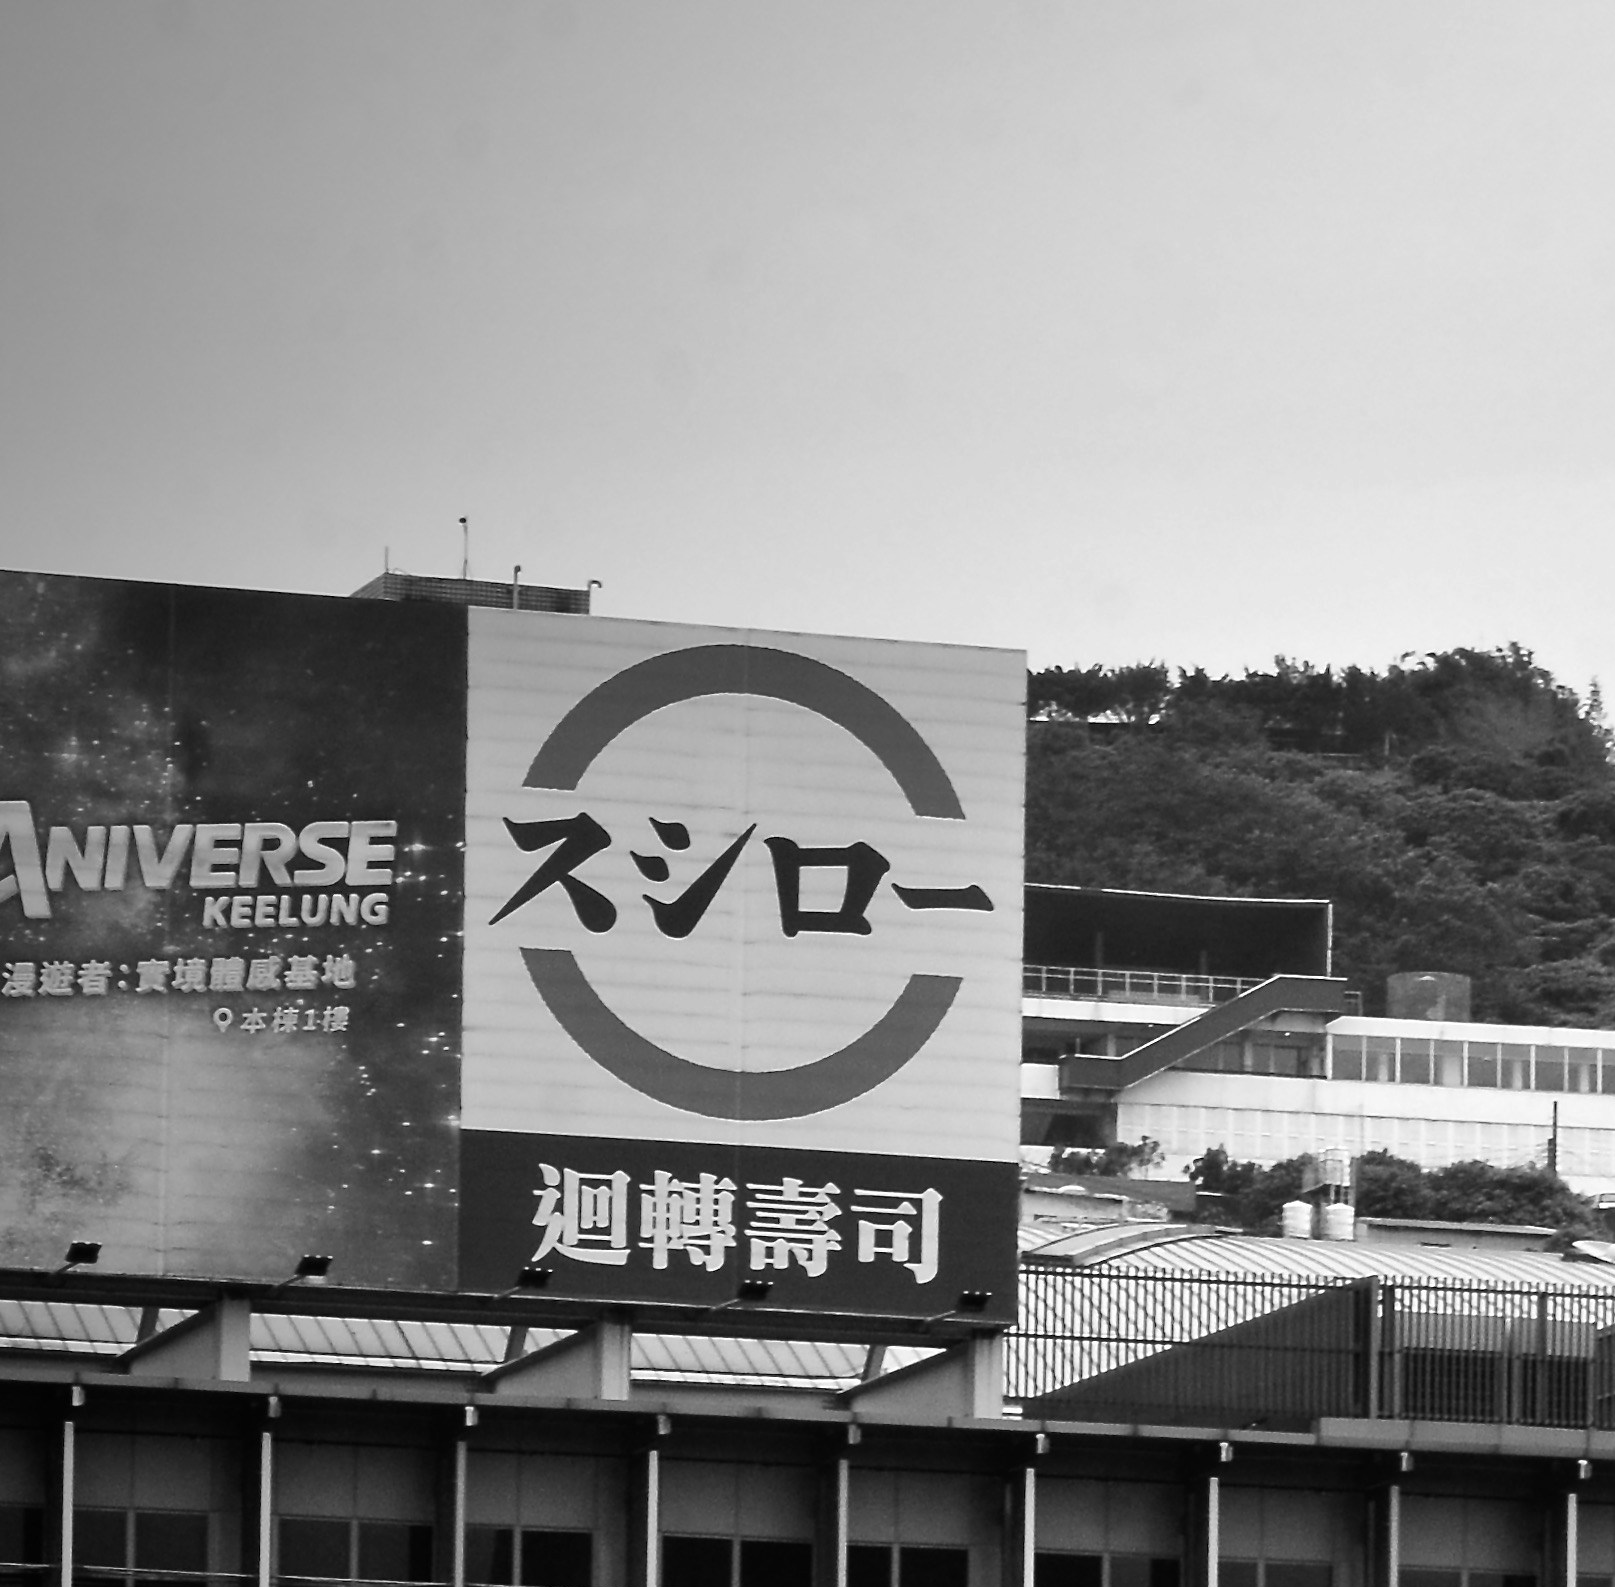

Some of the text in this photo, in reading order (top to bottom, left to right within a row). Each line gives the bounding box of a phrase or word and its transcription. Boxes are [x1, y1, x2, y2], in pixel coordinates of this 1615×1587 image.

[203, 893, 389, 929] KEELUNG
[488, 812, 995, 940] スシロー
[531, 1163, 944, 1284] 迴轉壽司
